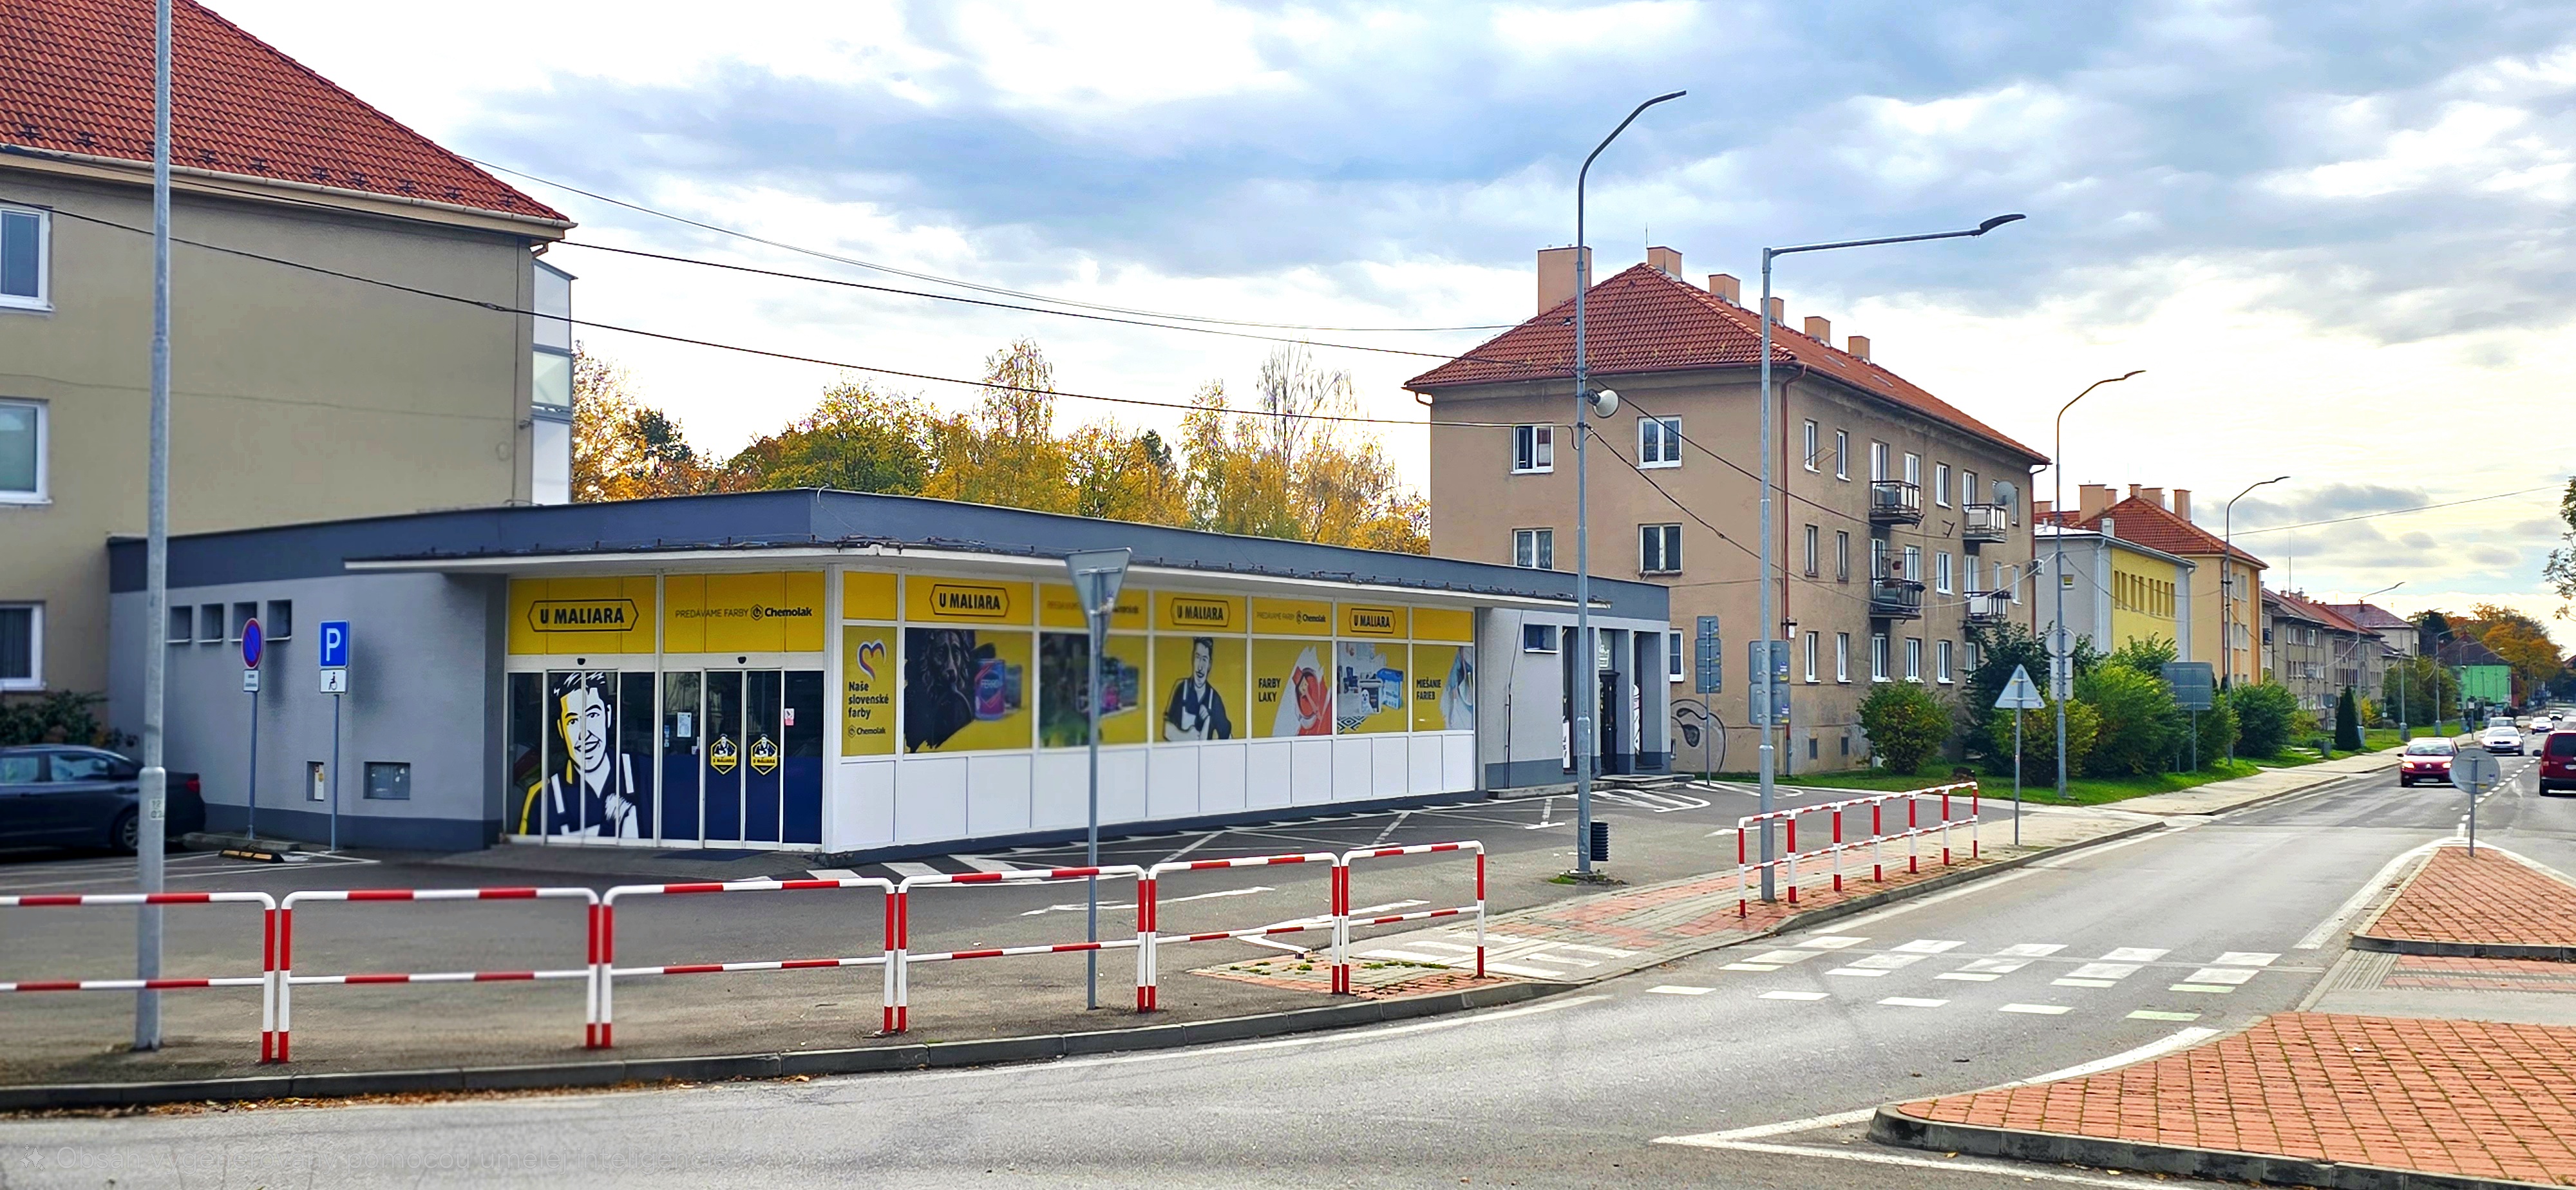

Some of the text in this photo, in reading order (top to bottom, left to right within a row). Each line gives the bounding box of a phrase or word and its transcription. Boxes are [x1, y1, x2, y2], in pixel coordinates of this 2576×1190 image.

[940, 593, 1000, 610] U MALIARA
[540, 607, 625, 624] U MALIARA
[675, 607, 813, 618] PREDÁVAME FARBY Chemolak
[1177, 605, 1224, 621] U MALIARA
[1354, 615, 1390, 628] U MALIARA
[327, 628, 341, 661] P
[849, 681, 869, 692] Naše
[1258, 678, 1281, 688] FARBY
[848, 694, 889, 704] slovenské
[1258, 692, 1277, 702] LAKY
[848, 707, 871, 719] farby
